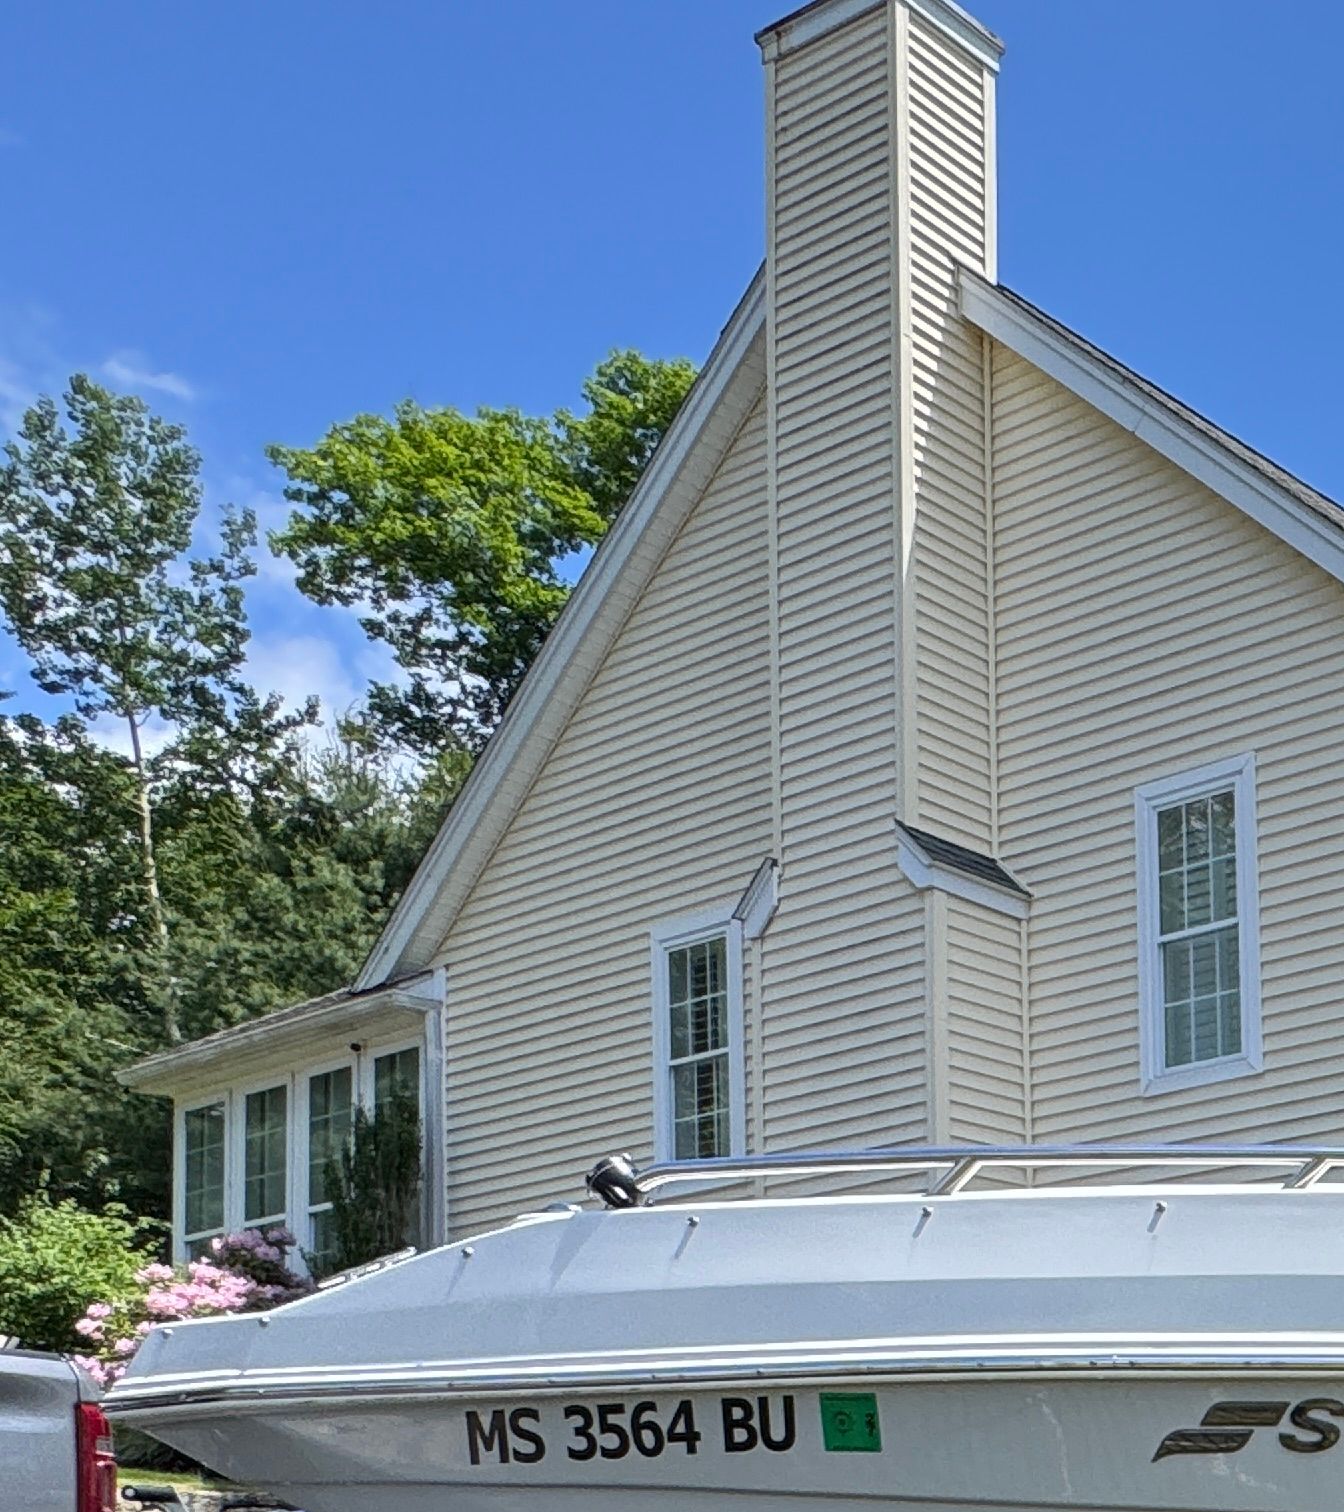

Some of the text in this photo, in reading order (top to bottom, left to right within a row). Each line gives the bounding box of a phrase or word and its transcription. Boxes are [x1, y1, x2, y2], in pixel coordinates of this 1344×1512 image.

[465, 1409, 546, 1465] MS
[563, 1399, 701, 1461] 3564
[721, 1395, 796, 1453] BU
